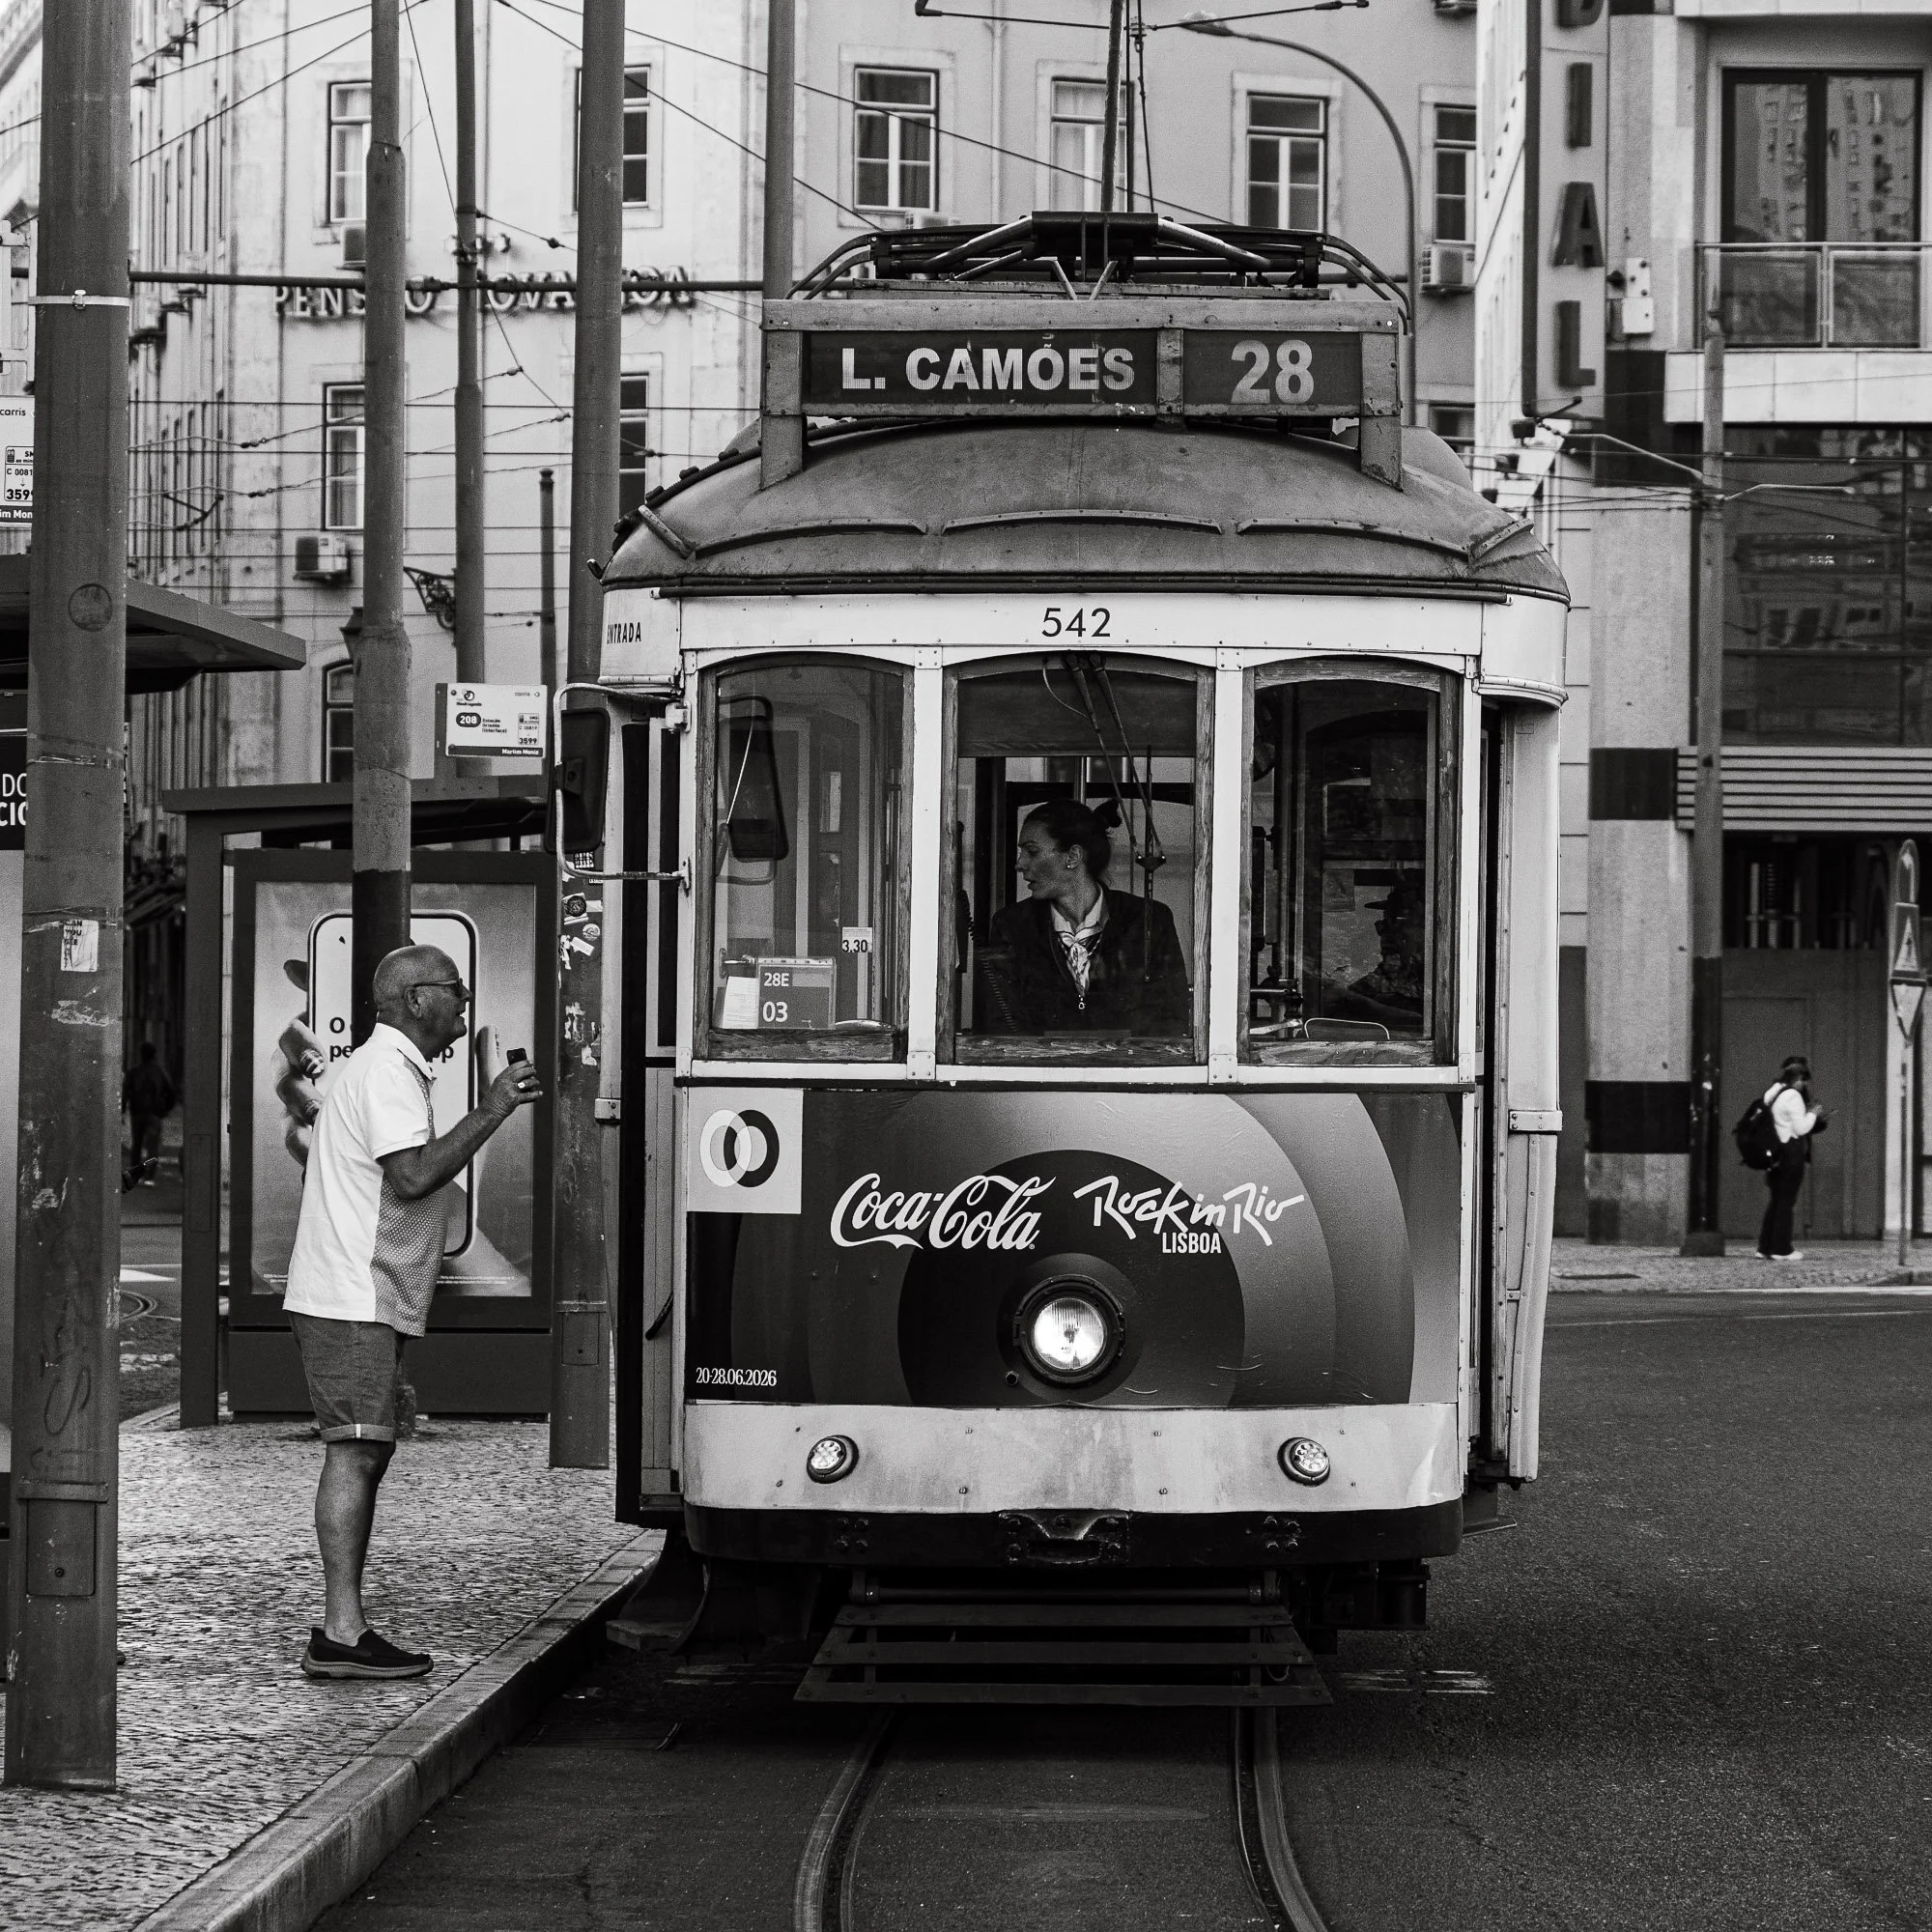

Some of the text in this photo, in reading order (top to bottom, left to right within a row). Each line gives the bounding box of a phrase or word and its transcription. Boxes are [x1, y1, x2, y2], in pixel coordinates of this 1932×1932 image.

[272, 274, 435, 317] PENSO
[477, 269, 576, 311] OVA
[841, 342, 1136, 391] L. CAMÕES
[1230, 339, 1315, 405] 28
[0, 407, 27, 416] carris
[6, 488, 34, 500] 359
[13, 509, 34, 520] Mon
[606, 621, 641, 645] ENTRADA
[1041, 607, 1112, 639] 542
[459, 715, 478, 724] 208
[841, 939, 868, 953] 3.30
[763, 972, 790, 987] 28E
[762, 1001, 788, 1023] 03
[830, 1172, 1057, 1250] Coca-Cola
[1072, 1175, 1305, 1247] Rock in Rio
[1161, 1232, 1222, 1254] LISBOA
[696, 1367, 778, 1387] 20-28.06.2026
